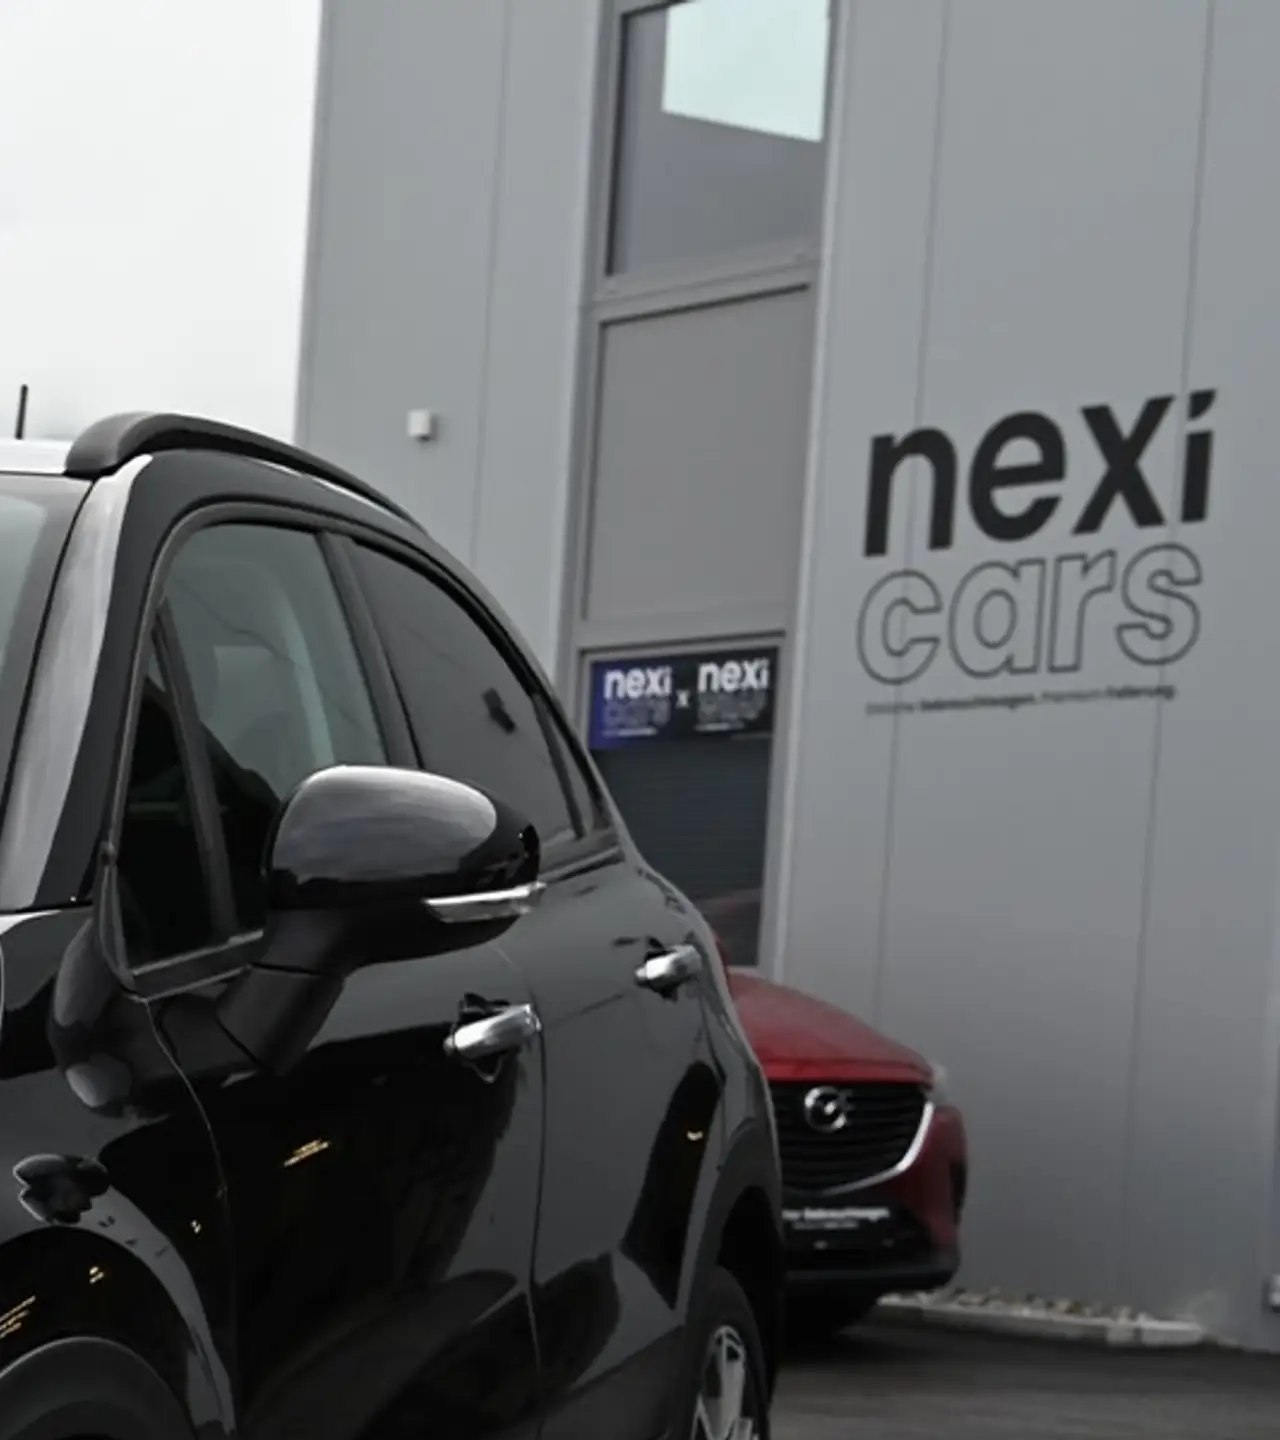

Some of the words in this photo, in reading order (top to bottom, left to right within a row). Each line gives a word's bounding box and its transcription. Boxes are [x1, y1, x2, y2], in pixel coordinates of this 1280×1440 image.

[864, 388, 1216, 557] nexi
[604, 666, 673, 700] nexi
[697, 657, 770, 693] nexi
[856, 542, 1203, 686] cars
